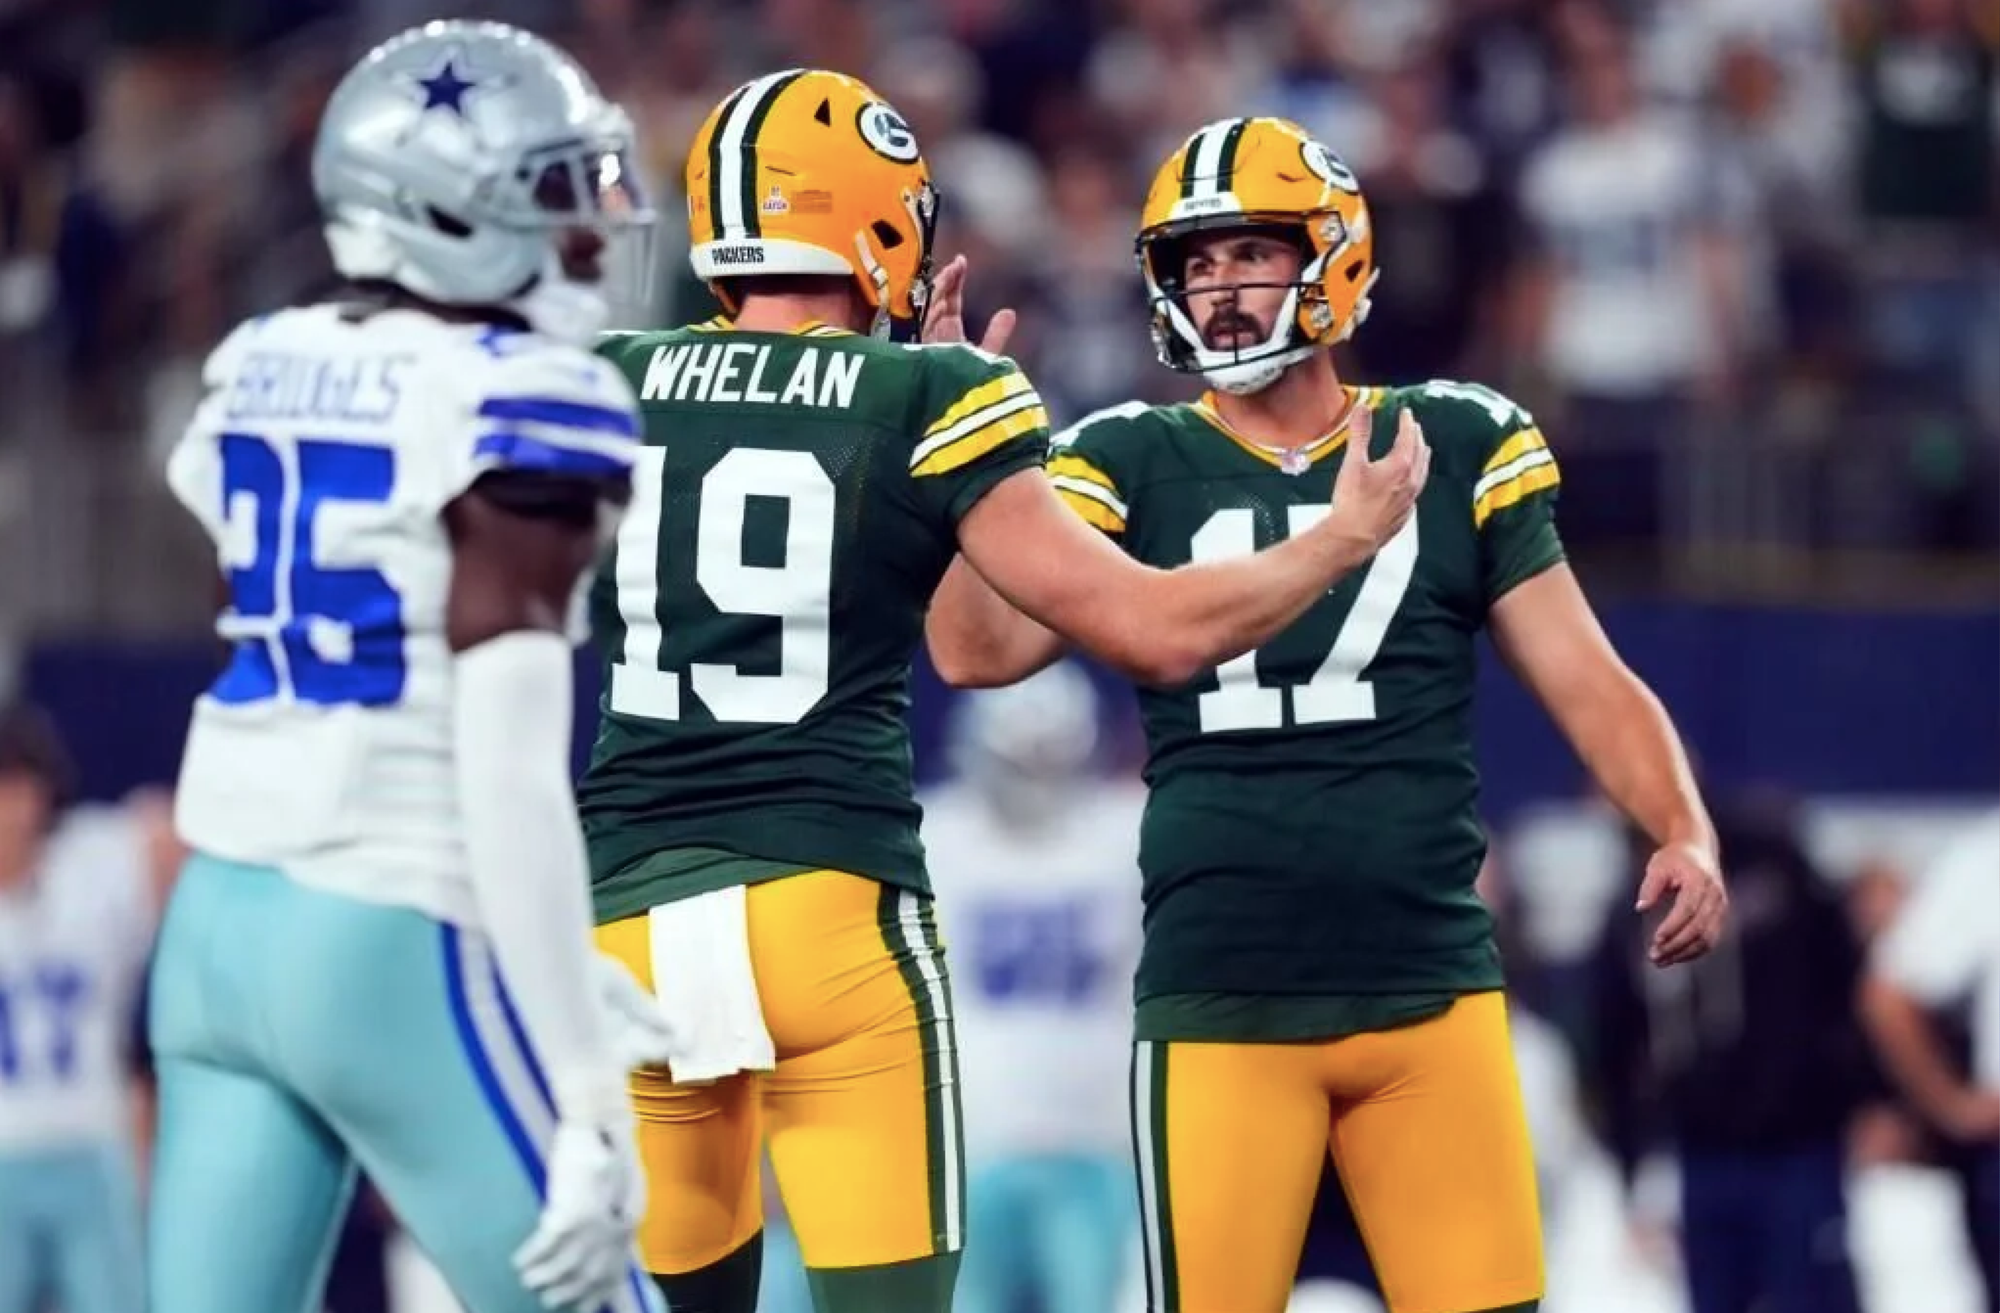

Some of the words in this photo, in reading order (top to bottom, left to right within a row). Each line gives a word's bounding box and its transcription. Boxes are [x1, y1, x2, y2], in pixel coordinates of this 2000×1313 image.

[711, 245, 765, 265] PACKERS
[640, 343, 866, 409] WHELAN
[611, 446, 836, 724] 19
[1191, 500, 1420, 733] 17
